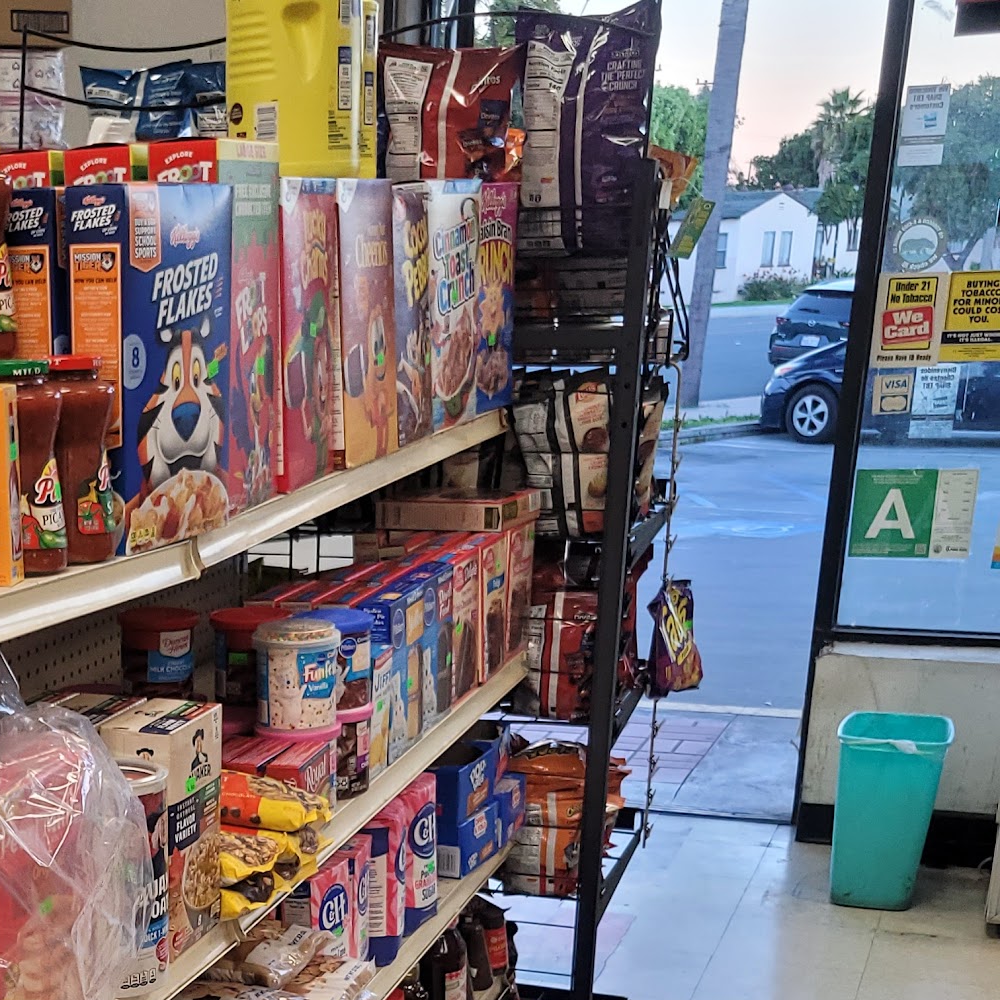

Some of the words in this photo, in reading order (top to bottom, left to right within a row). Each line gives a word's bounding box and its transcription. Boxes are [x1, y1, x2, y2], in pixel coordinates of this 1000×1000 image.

[601, 71, 616, 80] THE
[80, 158, 108, 172] EXPLORE
[164, 151, 193, 165] EXPLORE
[71, 204, 117, 223] FROSTED
[73, 215, 113, 232] FLAKES
[134, 236, 157, 247] SCHOOL
[74, 253, 101, 262] MISSION
[134, 247, 157, 259] SPORTS
[151, 252, 219, 302] FROSTED
[895, 282, 919, 292] Under
[921, 281, 931, 291] 21
[966, 280, 1000, 289] BUYING
[890, 294, 901, 303] No
[903, 293, 933, 303] Tobacco
[953, 298, 971, 306] FOR
[156, 281, 214, 330] FLAKES
[953, 306, 982, 315] COULD
[892, 311, 924, 325] We
[884, 321, 930, 339] Card
[131, 346, 139, 368] 8
[12, 366, 42, 377] MILD
[885, 380, 907, 389] VISA
[864, 488, 916, 539] A
[303, 756, 328, 793] Royal
[176, 815, 197, 833] FLAVOR
[174, 826, 198, 844] VARIETY
[322, 891, 349, 932] C&H
